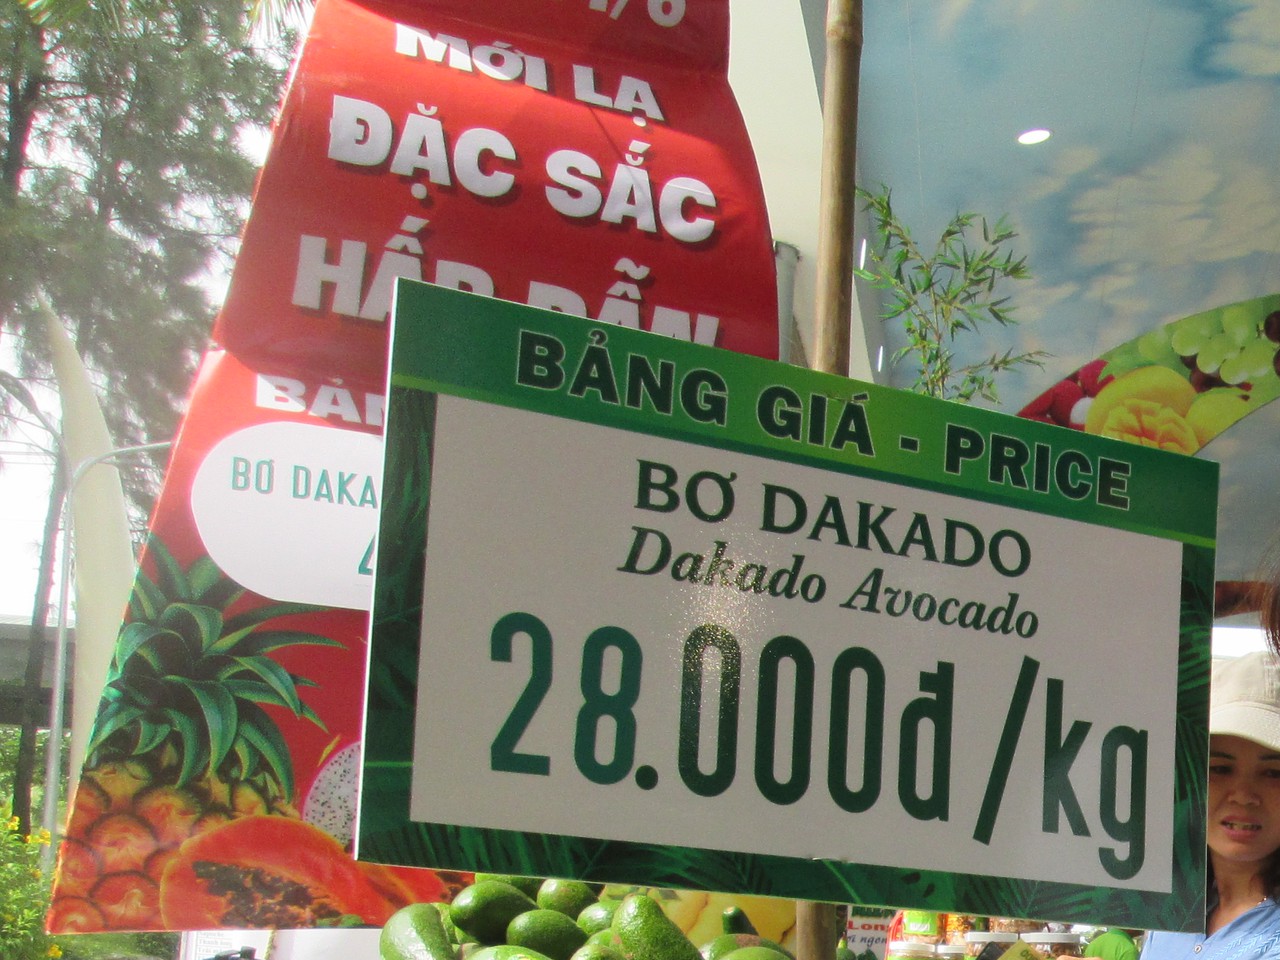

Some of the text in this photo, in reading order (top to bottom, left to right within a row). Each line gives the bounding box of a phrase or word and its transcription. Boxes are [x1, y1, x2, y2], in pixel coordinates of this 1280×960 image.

[395, 22, 665, 127] MỚI LẠ
[327, 94, 717, 243] ĐẶC SẮC
[516, 329, 729, 427] BẢNG
[756, 384, 875, 457] GIÁ
[944, 421, 1132, 511] PRICE
[633, 457, 1032, 578] BƠ DAKADO
[616, 524, 1040, 639] Dakado Avocado
